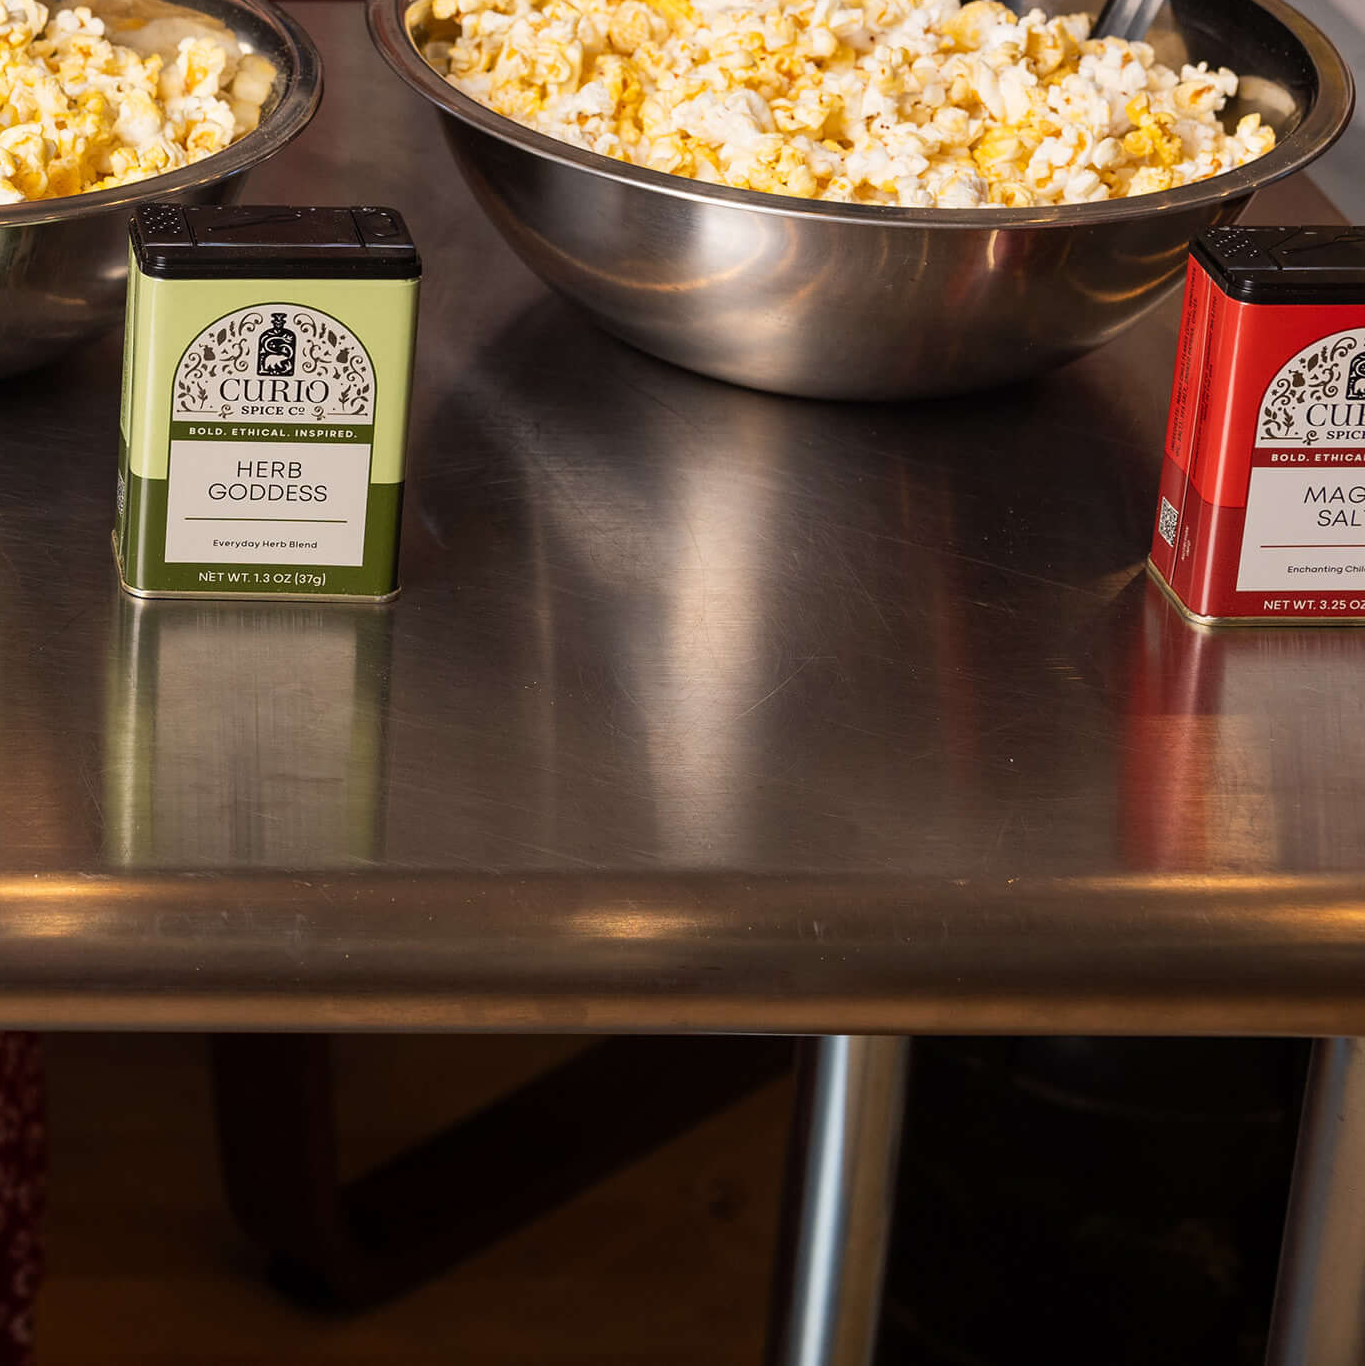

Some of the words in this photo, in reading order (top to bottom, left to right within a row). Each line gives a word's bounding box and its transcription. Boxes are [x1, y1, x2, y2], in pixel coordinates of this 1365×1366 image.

[219, 377, 330, 404] CURIO
[241, 405, 284, 416] SPICE
[189, 426, 228, 437] BOLD.
[232, 427, 291, 438] ETHICAL.
[294, 429, 358, 439] INSPIRED.
[1271, 453, 1310, 462] BOLD.
[1315, 453, 1365, 462] ETHICA
[237, 461, 303, 479] HERB
[208, 483, 328, 503] GODDESS
[1304, 486, 1365, 504] MAG
[1317, 509, 1365, 527] SAL
[212, 539, 260, 549] Everyday
[262, 540, 287, 549] Herb
[289, 540, 318, 550] Blend
[1287, 565, 1343, 575] Enchanting
[198, 571, 225, 583] NET
[227, 572, 251, 584] WT.
[253, 572, 270, 584] 1.3
[273, 573, 292, 585] OZ
[294, 572, 326, 586] (37g)
[1263, 600, 1290, 610] NET
[1293, 600, 1317, 610] WT.
[1319, 600, 1347, 610] 3.25
